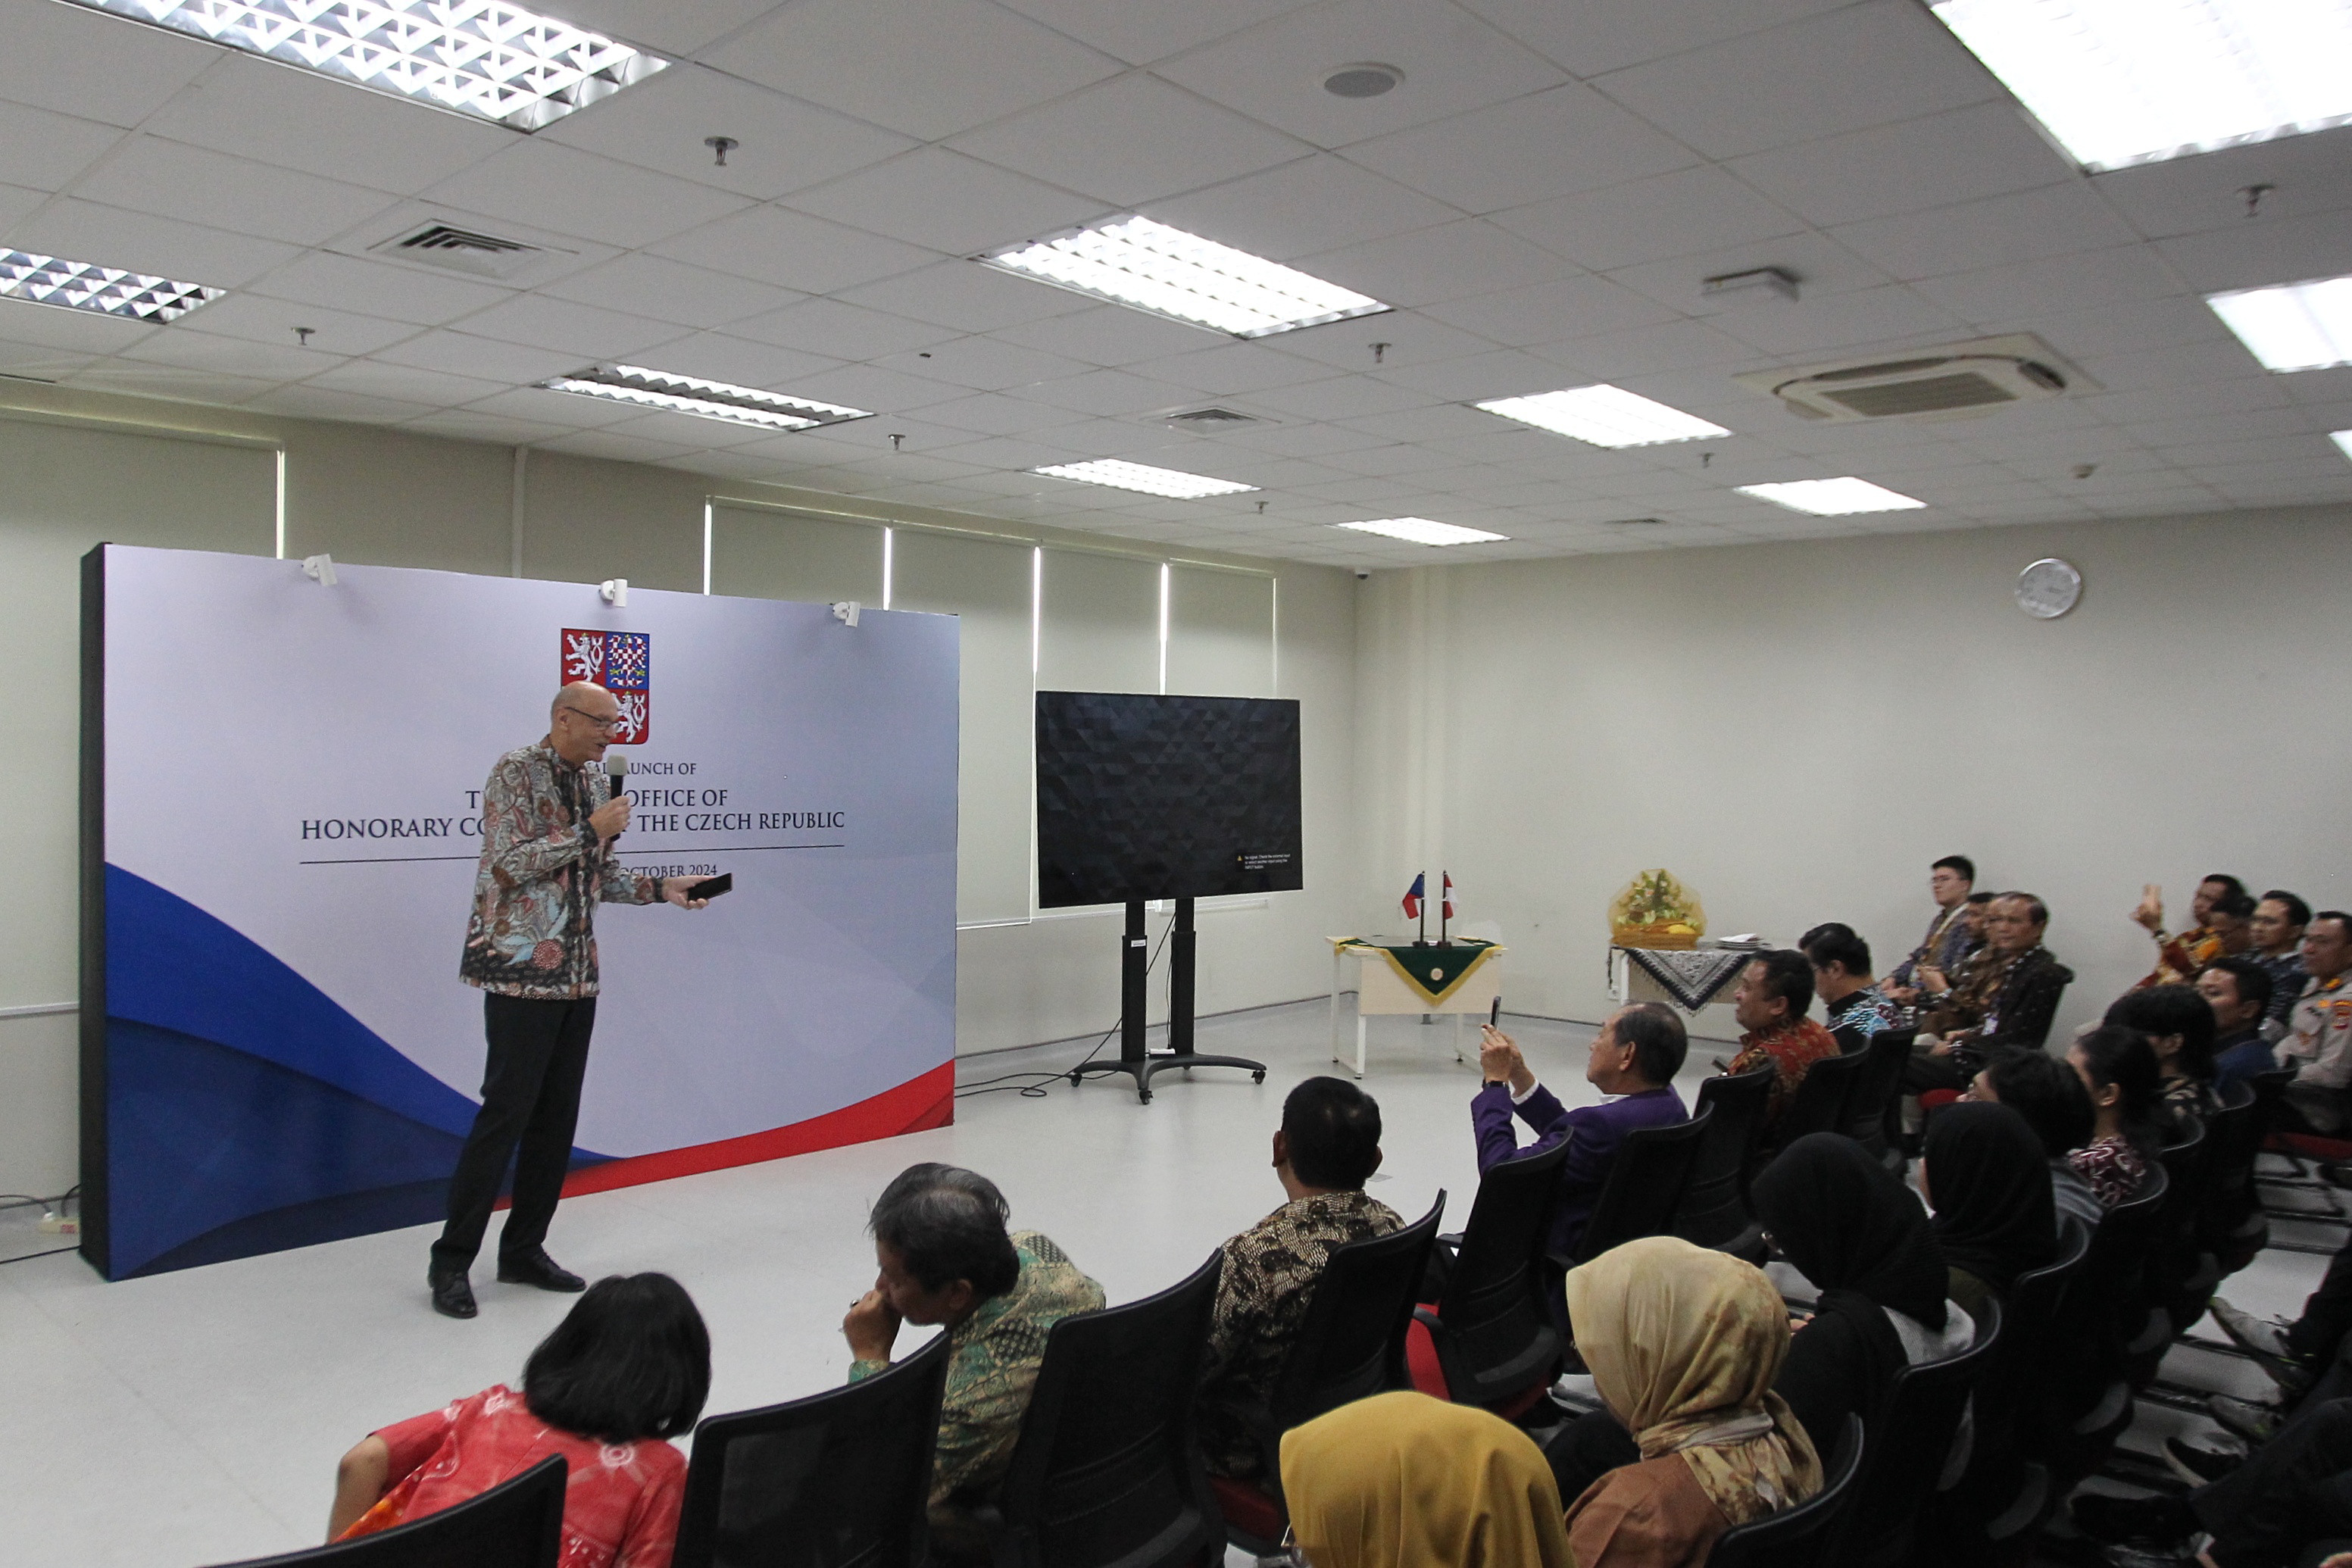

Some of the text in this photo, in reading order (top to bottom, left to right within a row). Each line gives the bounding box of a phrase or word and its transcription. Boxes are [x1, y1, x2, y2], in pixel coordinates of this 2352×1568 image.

[626, 762, 697, 776] UNCH OF
[623, 789, 728, 807] OFFICE OF
[301, 817, 453, 840] HONORARY
[636, 814, 679, 832] THE
[685, 813, 751, 832] CZECH
[759, 811, 845, 829] REPUBLIC
[689, 864, 718, 876] 2024
